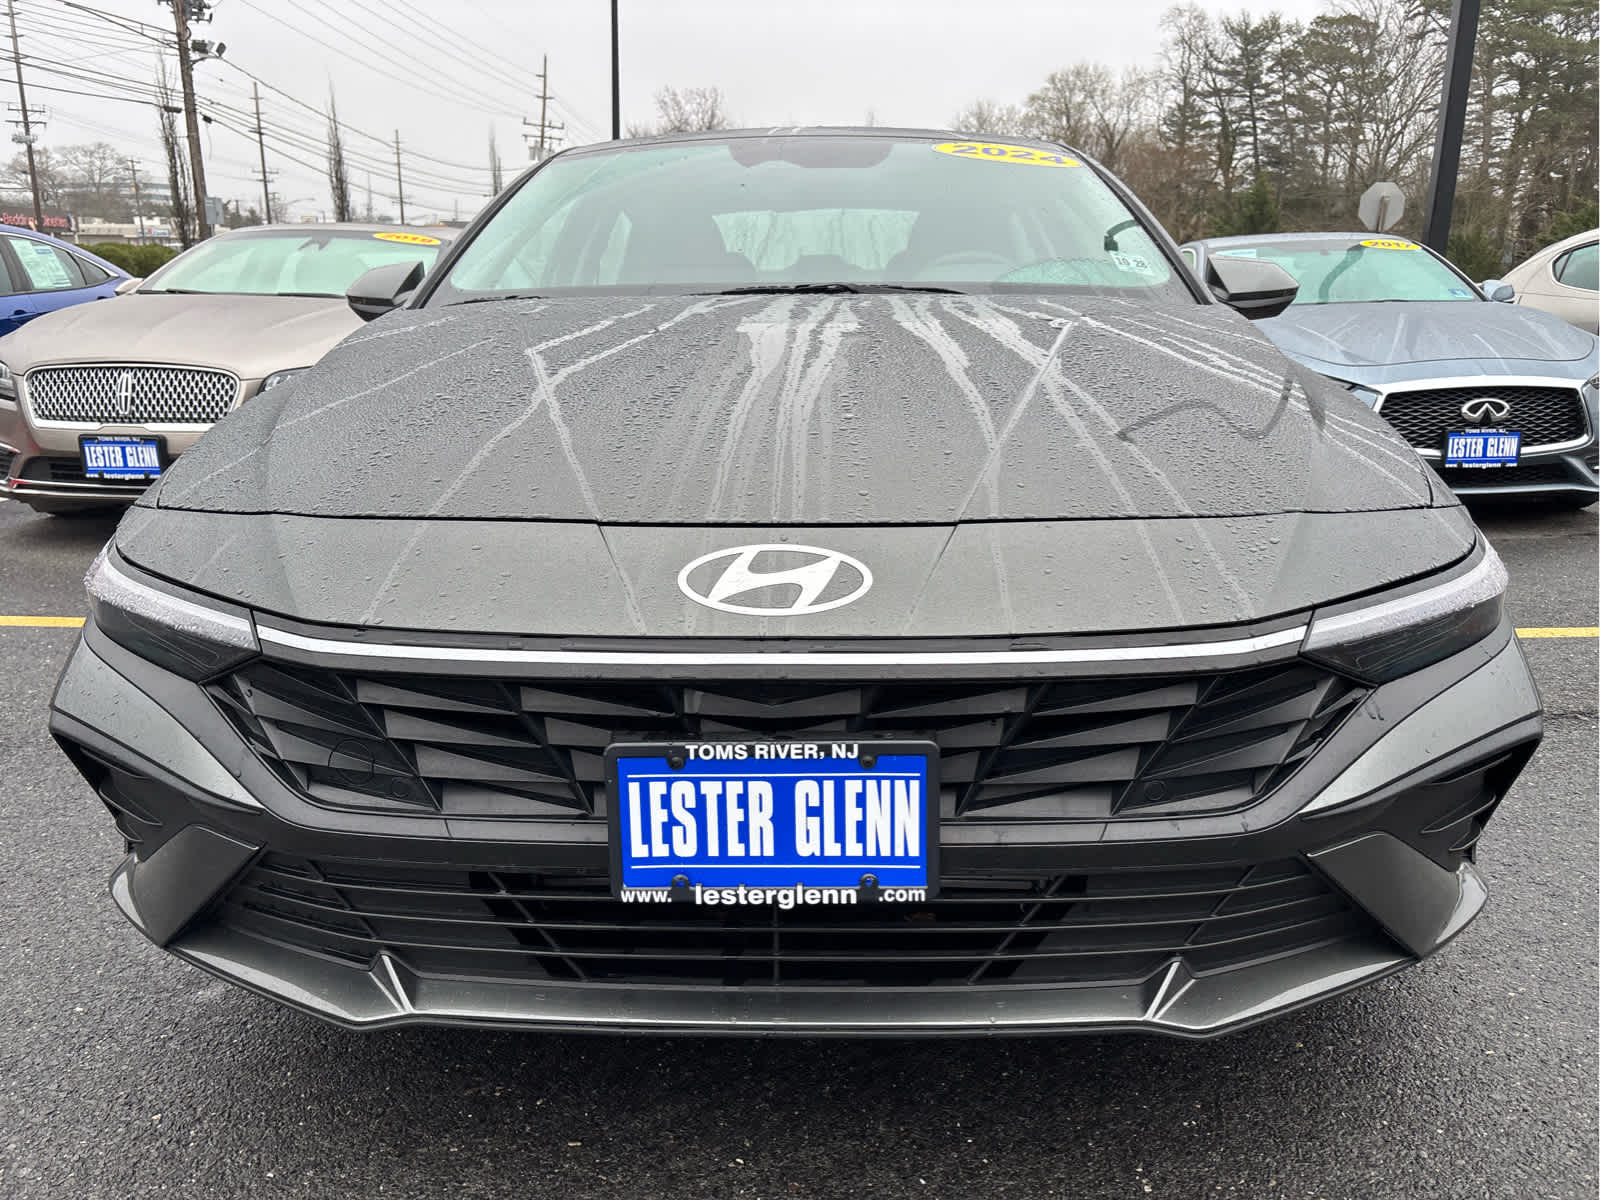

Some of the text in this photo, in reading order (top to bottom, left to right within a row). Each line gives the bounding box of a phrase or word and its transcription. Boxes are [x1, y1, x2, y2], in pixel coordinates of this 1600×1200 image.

[951, 144, 1067, 164] 2024
[84, 446, 159, 467] LESTER GLENN
[1447, 437, 1518, 458] LESTER GLENN
[685, 743, 859, 760] TOMS RIVER, NJ
[628, 779, 920, 858] LESTER GLENN
[620, 884, 926, 910] www. lesterglenn .com
